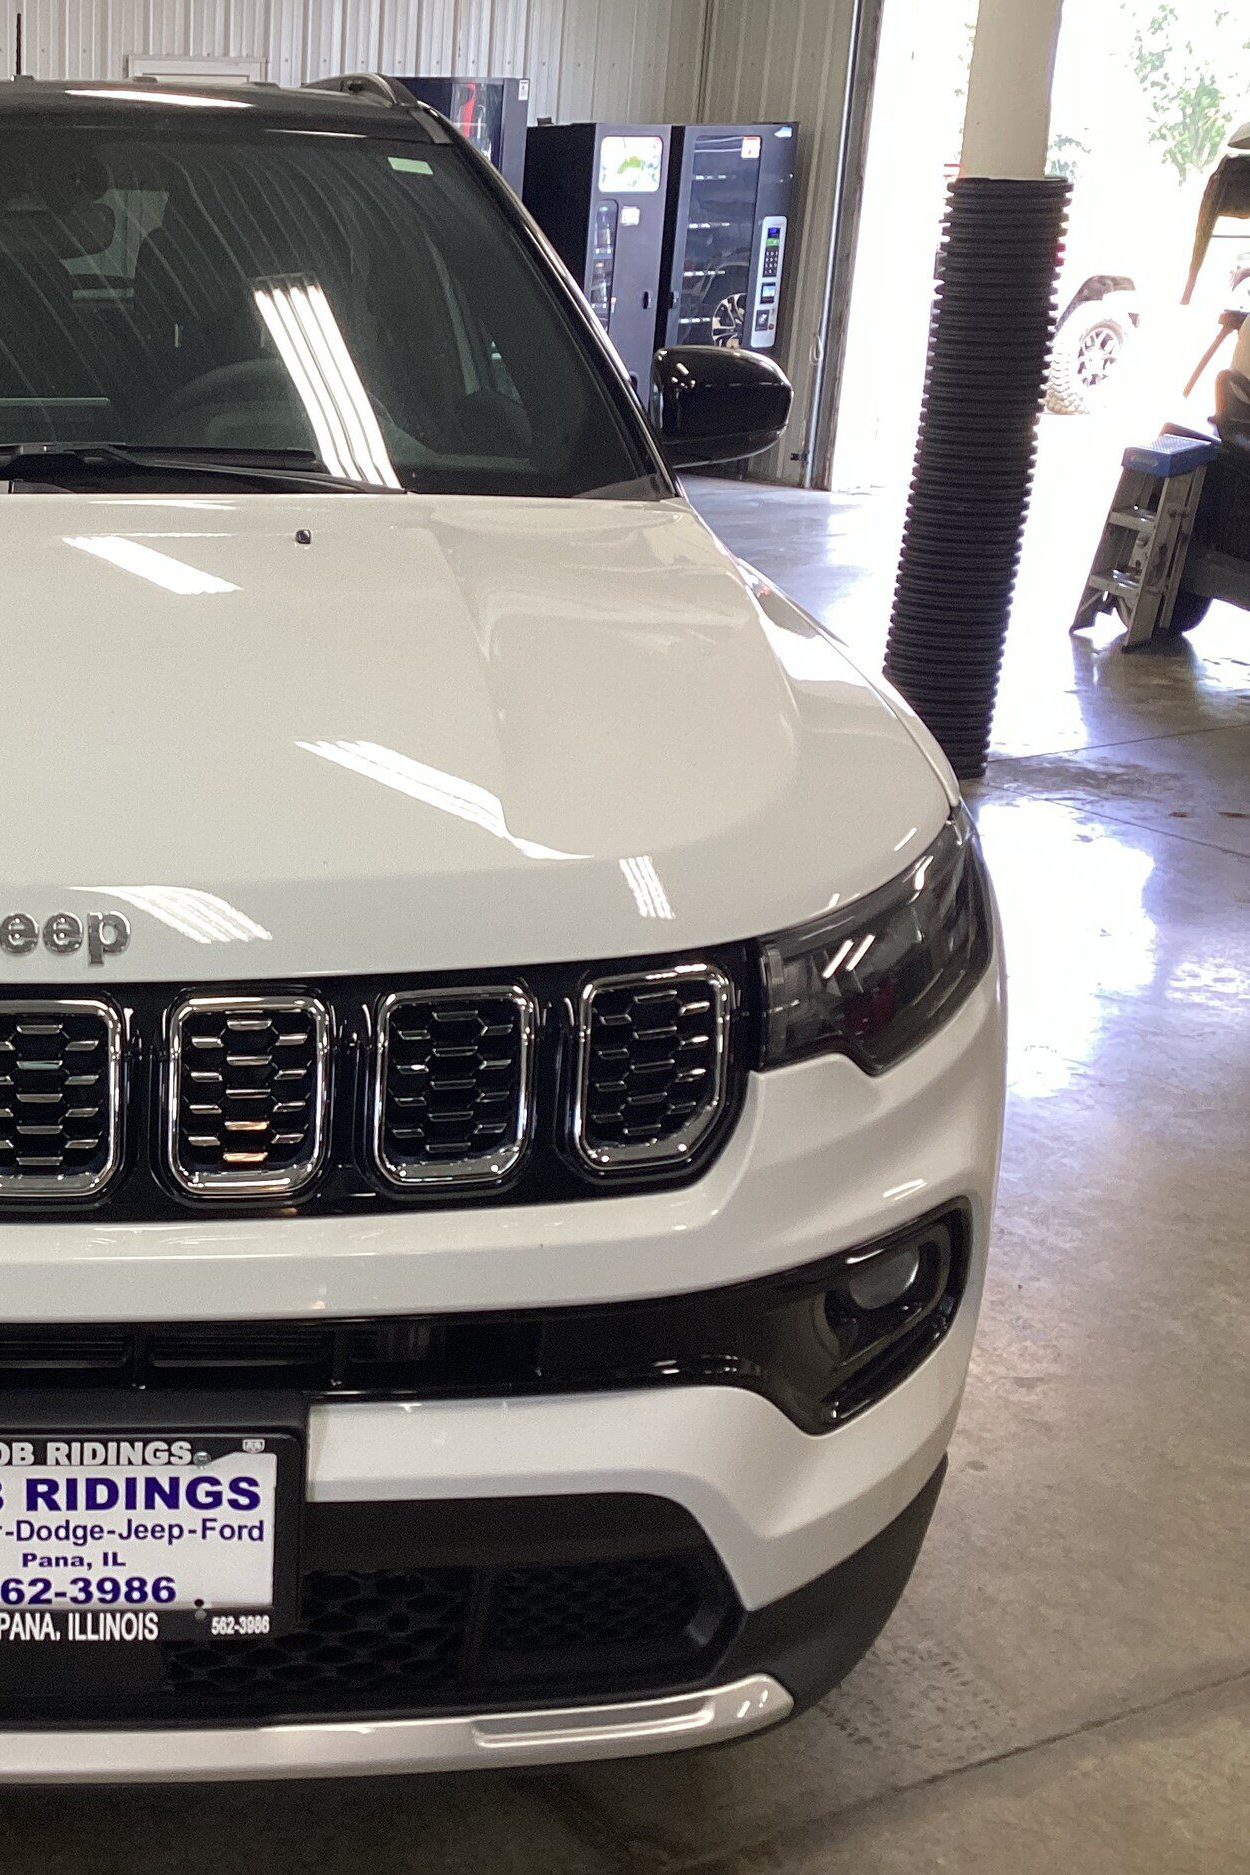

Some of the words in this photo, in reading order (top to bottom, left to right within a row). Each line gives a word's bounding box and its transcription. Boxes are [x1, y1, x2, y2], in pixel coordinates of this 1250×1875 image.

[47, 1440, 192, 1466] RIDINGS
[26, 1476, 261, 1512] RIDINGS
[22, 1552, 93, 1571] Pana,
[102, 1551, 126, 1567] IL
[67, 1611, 159, 1641] ILLINOIS
[210, 1615, 271, 1636] 562-3986
